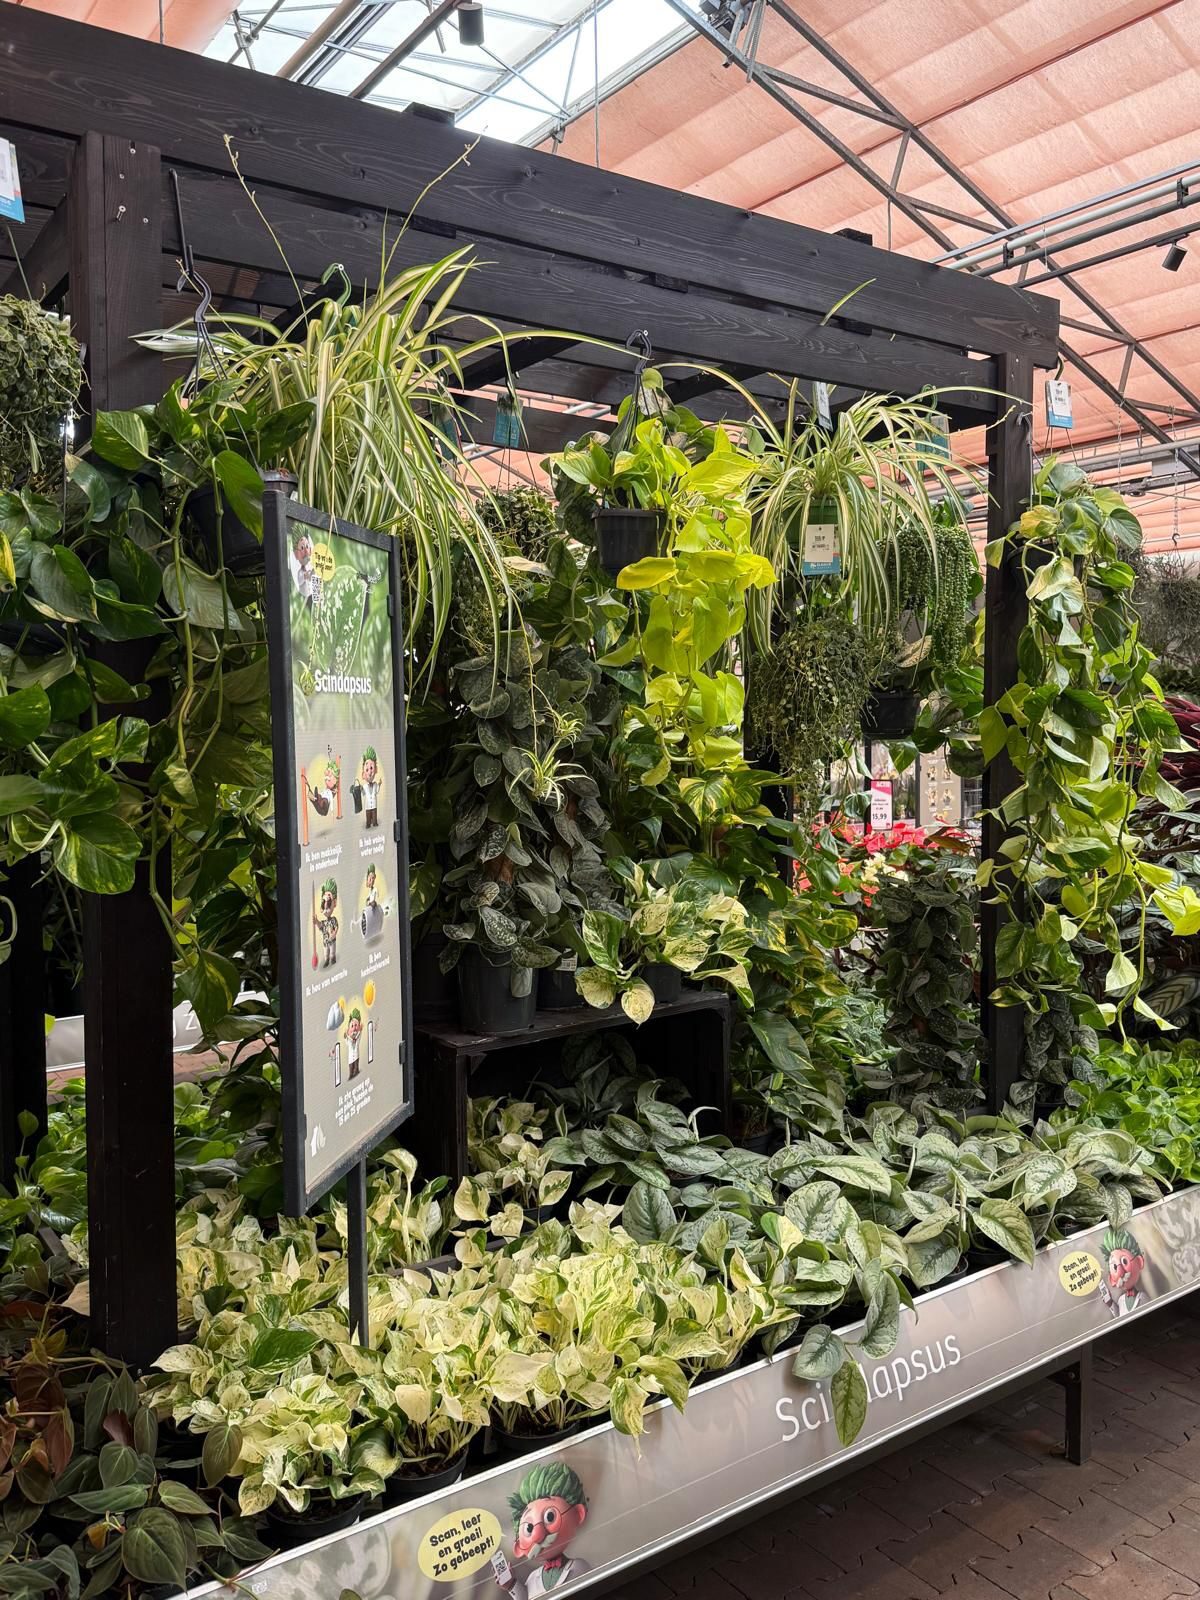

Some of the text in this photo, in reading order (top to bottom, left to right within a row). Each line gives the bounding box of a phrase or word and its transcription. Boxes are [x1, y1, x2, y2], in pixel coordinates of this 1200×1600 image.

[314, 668, 372, 699] Scindapsus
[872, 813, 888, 821] 15,99
[305, 852, 311, 863] Ik
[311, 851, 320, 861] ben
[1063, 1255, 1088, 1273] Scan, leer
[1069, 1283, 1078, 1292] Zo
[1070, 1272, 1078, 1281] en
[775, 1334, 961, 1442] Sciapsus
[429, 1513, 481, 1547] Scan, leer
[438, 1526, 483, 1558] en groei!
[432, 1535, 495, 1577] Zo gebeept!
